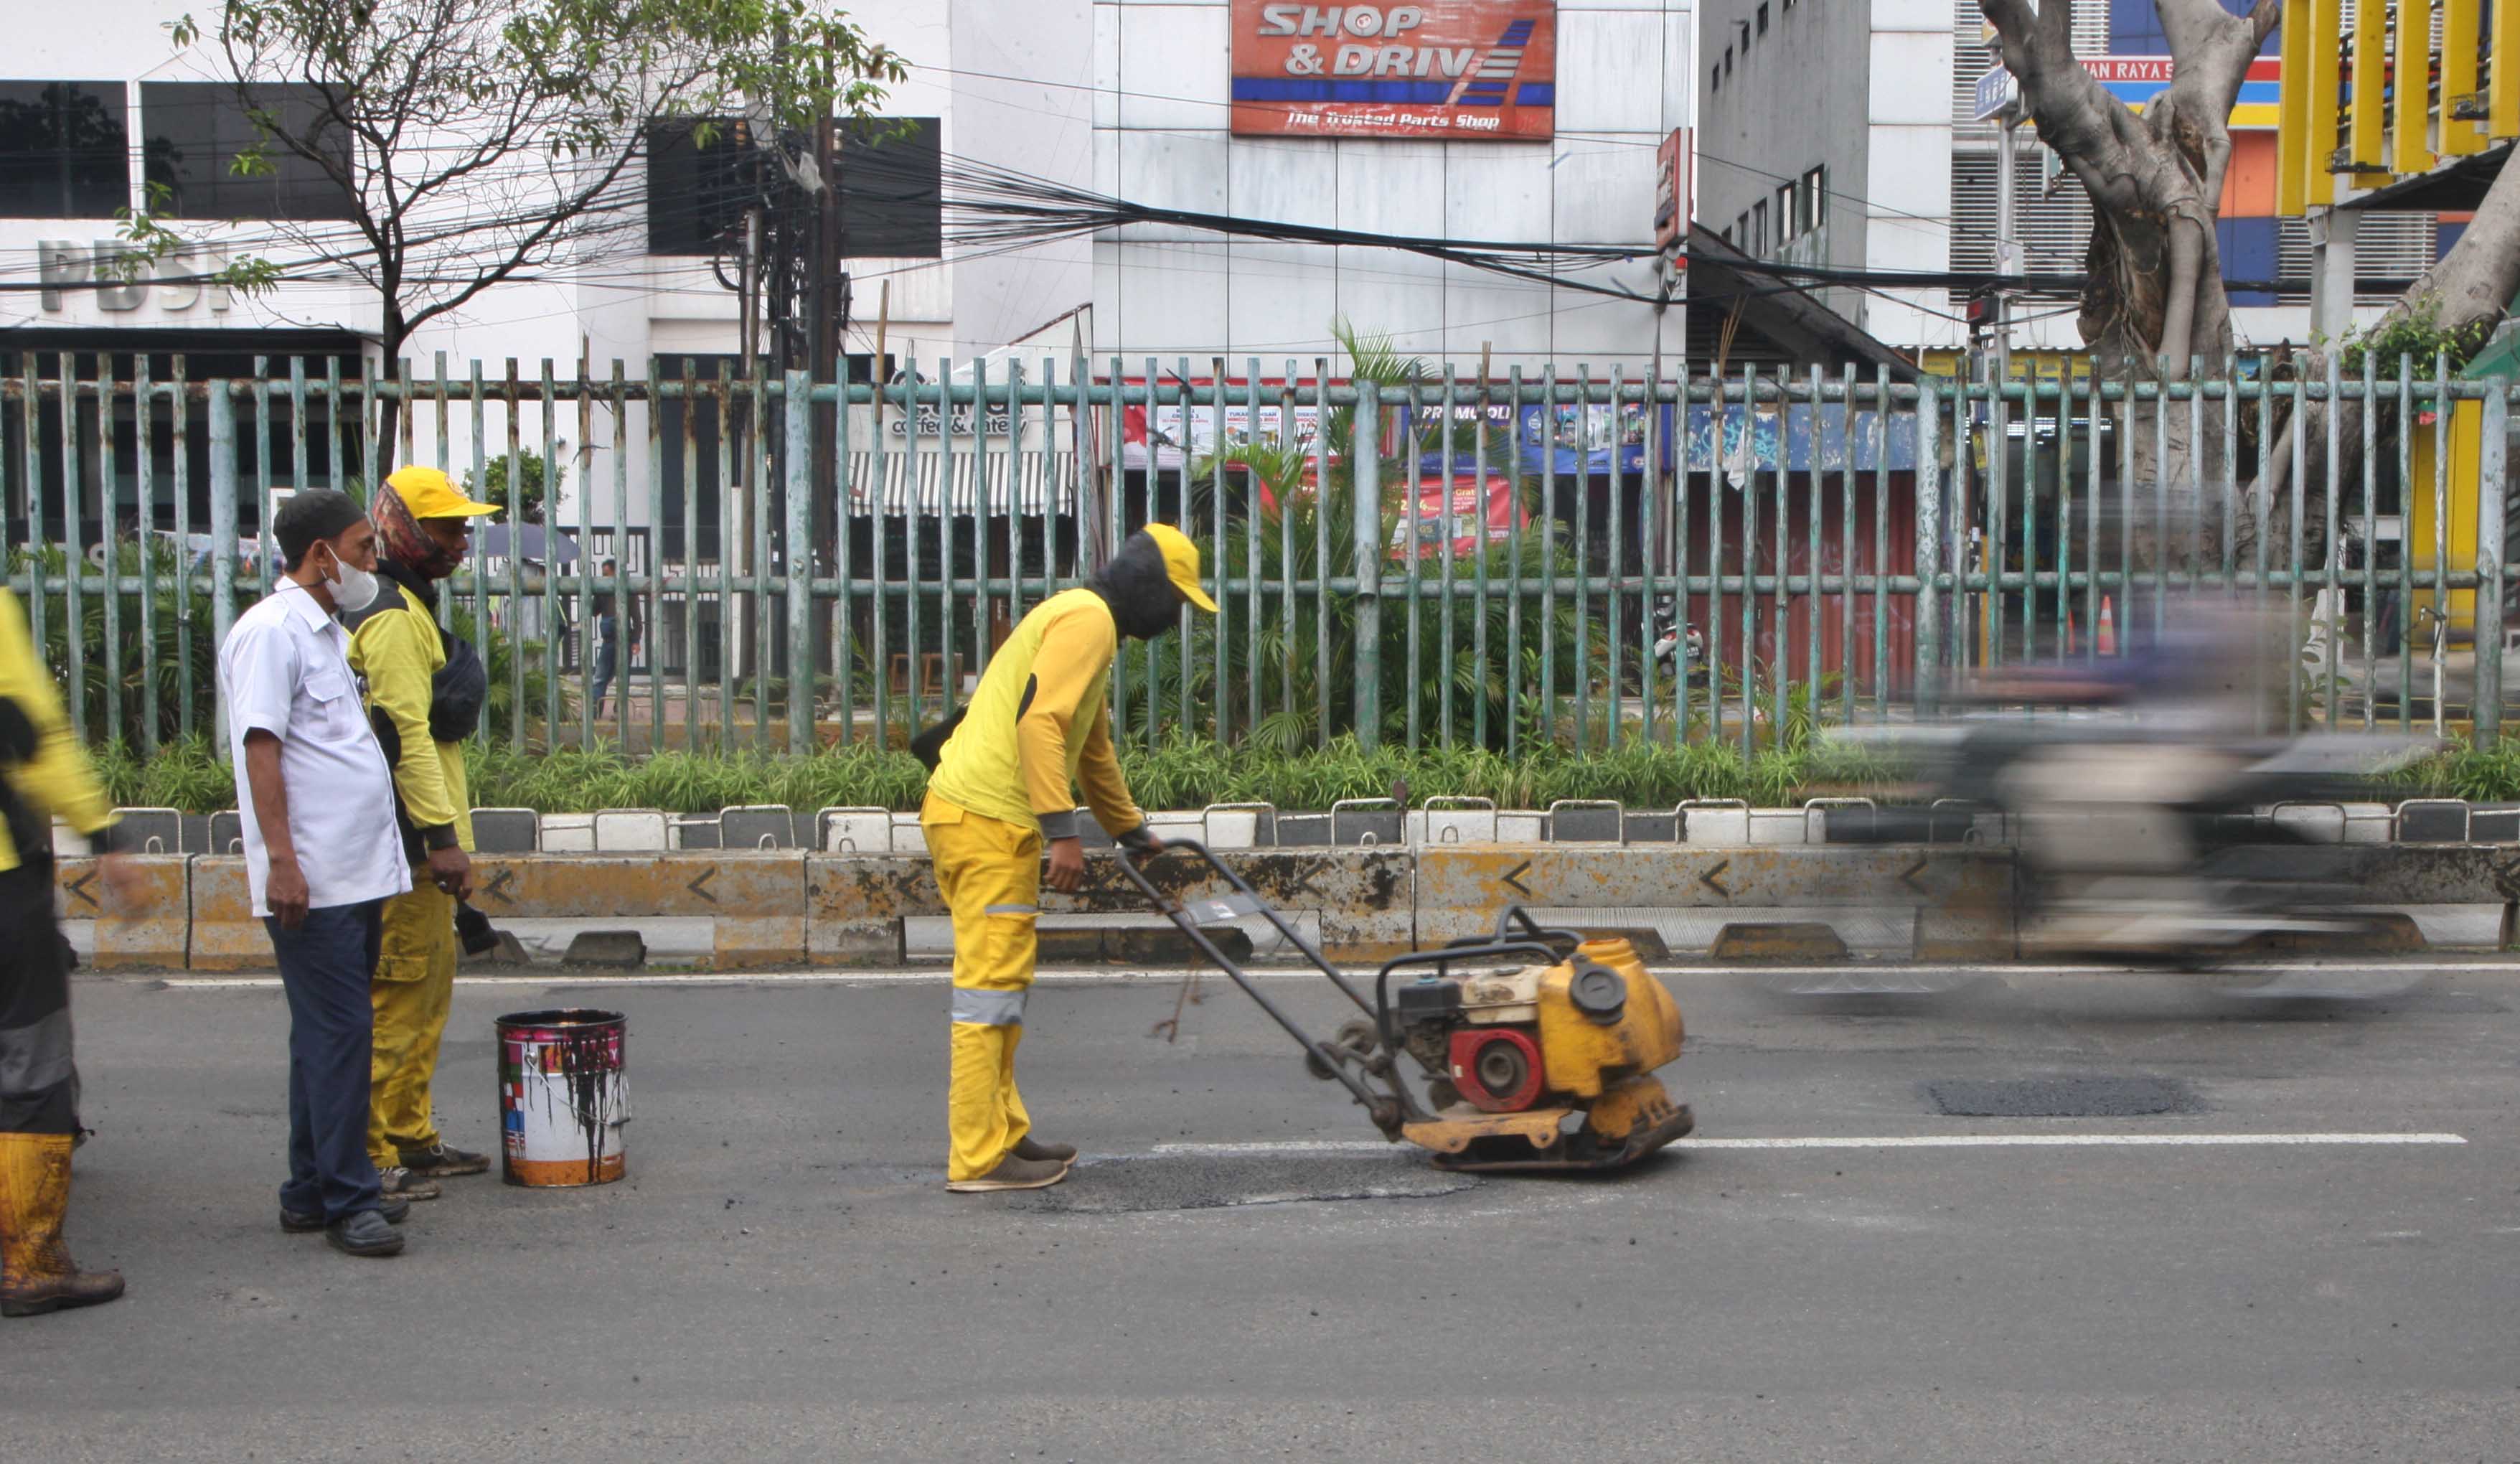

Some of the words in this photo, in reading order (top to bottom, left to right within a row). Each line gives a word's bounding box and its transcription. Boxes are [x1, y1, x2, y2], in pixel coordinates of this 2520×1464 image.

[1258, 5, 1423, 37] SHOP
[1284, 43, 1324, 75] &
[1333, 45, 1523, 78] DRIVE
[2117, 62, 2161, 79] RAYA
[1288, 112, 1318, 125] The
[1326, 111, 1393, 126] Trusted
[1400, 113, 1449, 128] Parts
[1455, 114, 1501, 130] Shop
[892, 417, 942, 433] cofe
[951, 417, 967, 433] &
